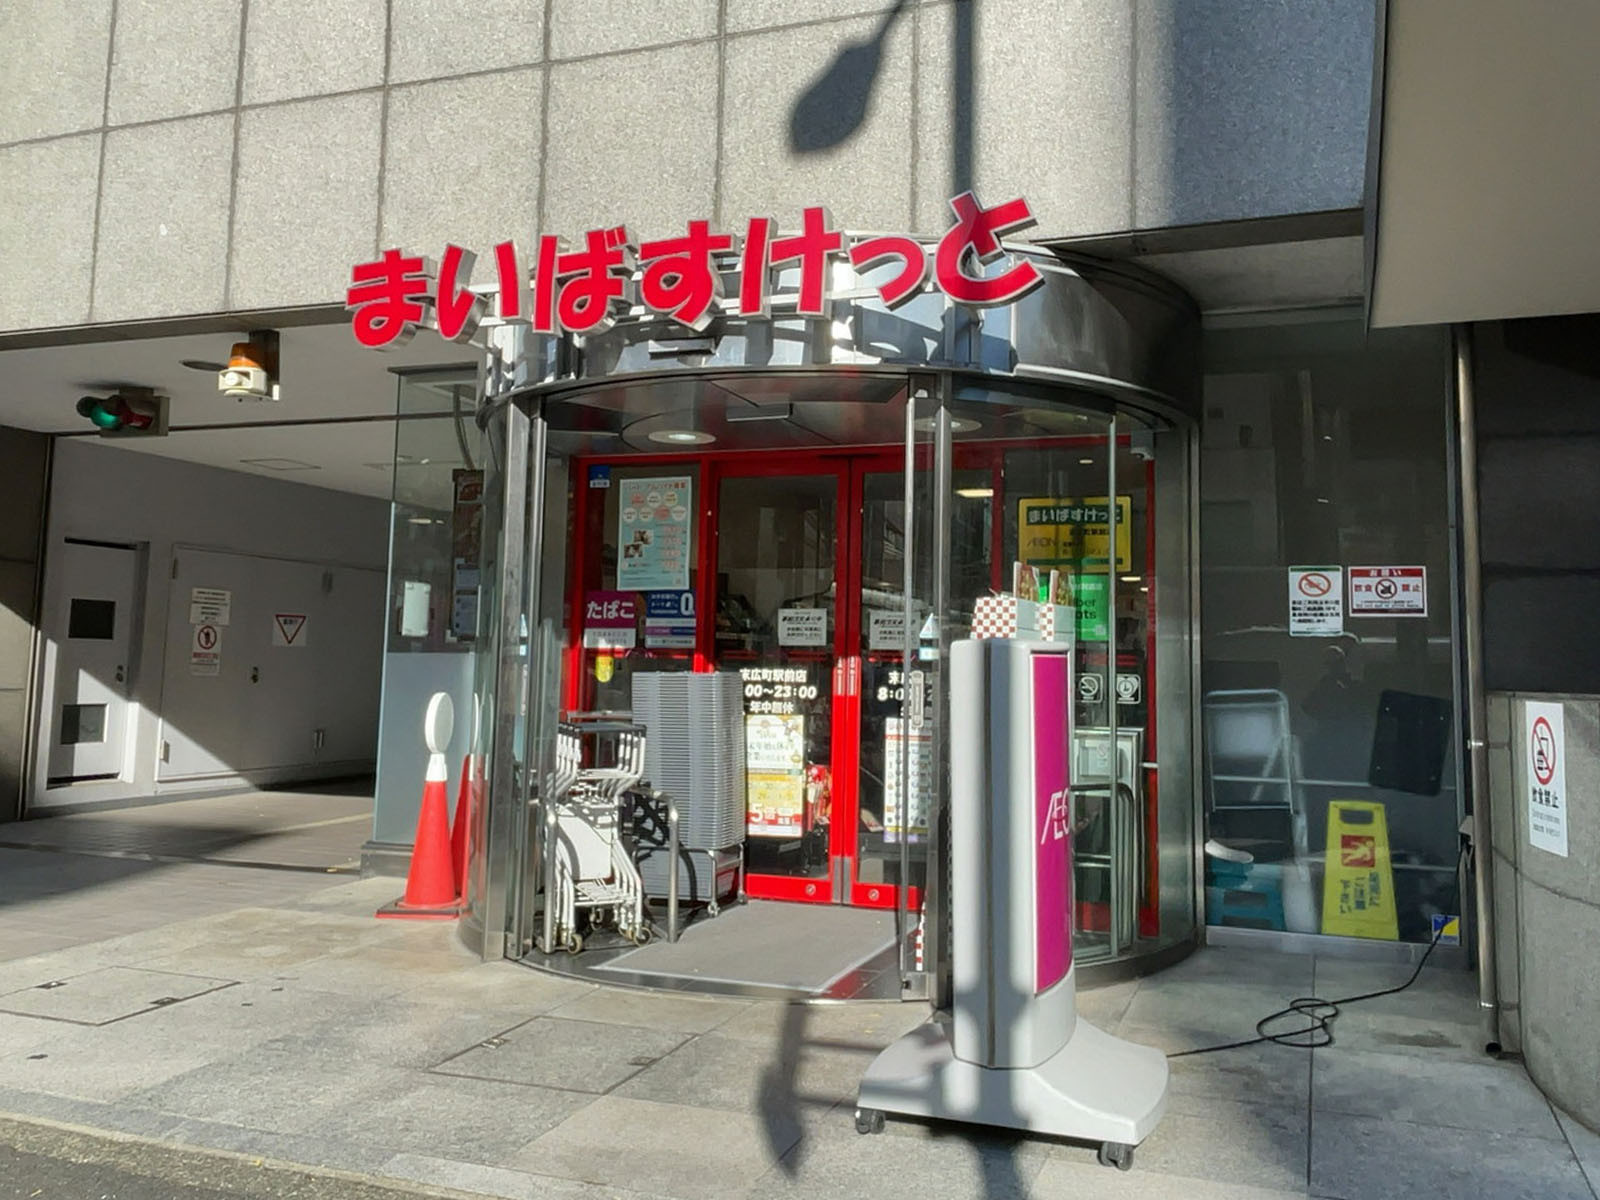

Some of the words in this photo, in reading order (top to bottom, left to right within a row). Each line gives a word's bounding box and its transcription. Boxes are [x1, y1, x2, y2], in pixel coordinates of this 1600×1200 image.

[346, 191, 1044, 348] まいばすけっと
[587, 600, 635, 619] たばこ
[1075, 598, 1096, 607] ber
[1075, 610, 1096, 620] ats
[740, 668, 807, 683] 末広町駅前店
[745, 684, 818, 699] 00~23:00
[750, 701, 794, 715] 年中無休
